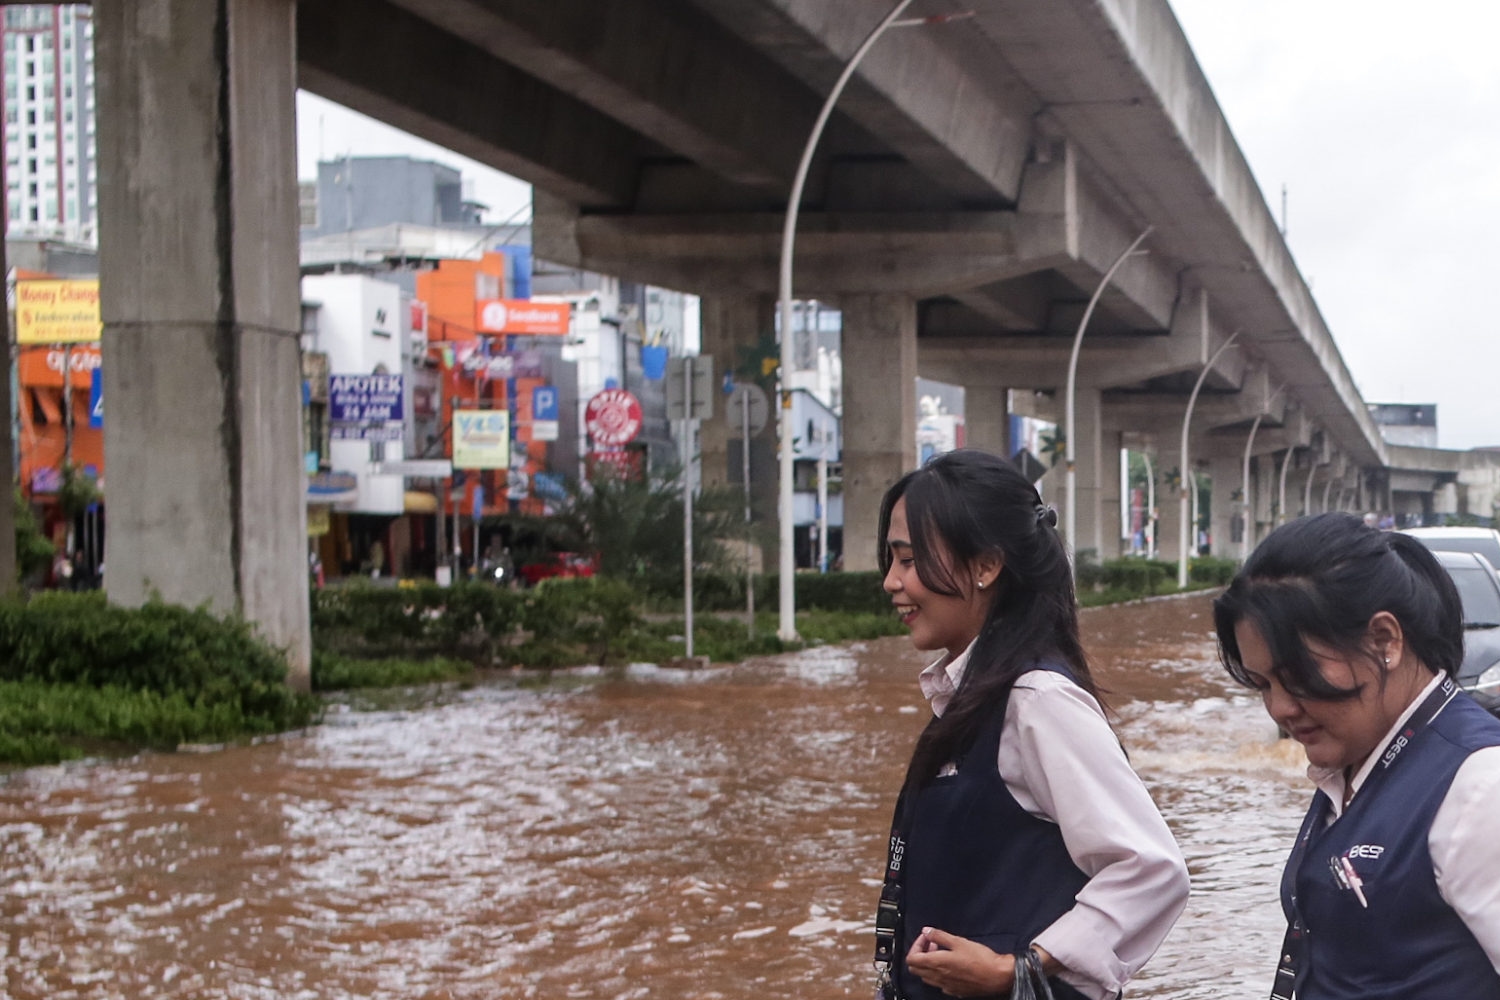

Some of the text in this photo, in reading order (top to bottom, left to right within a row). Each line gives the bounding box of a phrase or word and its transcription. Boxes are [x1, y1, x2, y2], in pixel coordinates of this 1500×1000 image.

[60, 282, 101, 307] Chang
[331, 375, 401, 393] APOTEK
[1381, 735, 1409, 769] BEST
[889, 836, 906, 871] BEST
